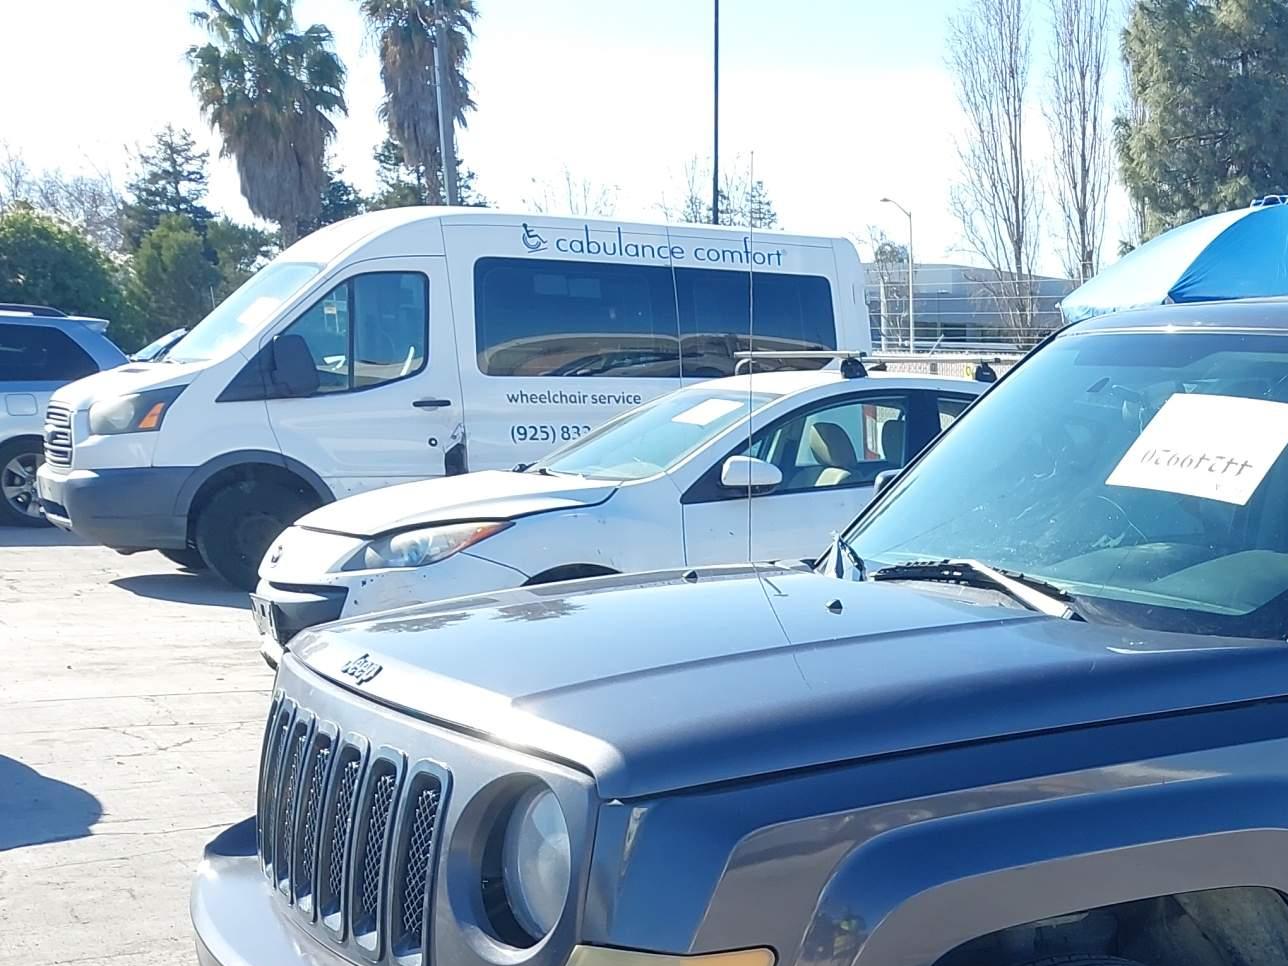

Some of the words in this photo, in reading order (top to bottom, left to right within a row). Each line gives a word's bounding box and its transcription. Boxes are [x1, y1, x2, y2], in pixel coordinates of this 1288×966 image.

[556, 224, 685, 260] cabulance
[694, 236, 783, 266] comfort
[507, 390, 588, 404] wheelchair
[591, 392, 642, 405] service
[511, 425, 557, 444] (925)
[341, 653, 384, 686] Jeep
